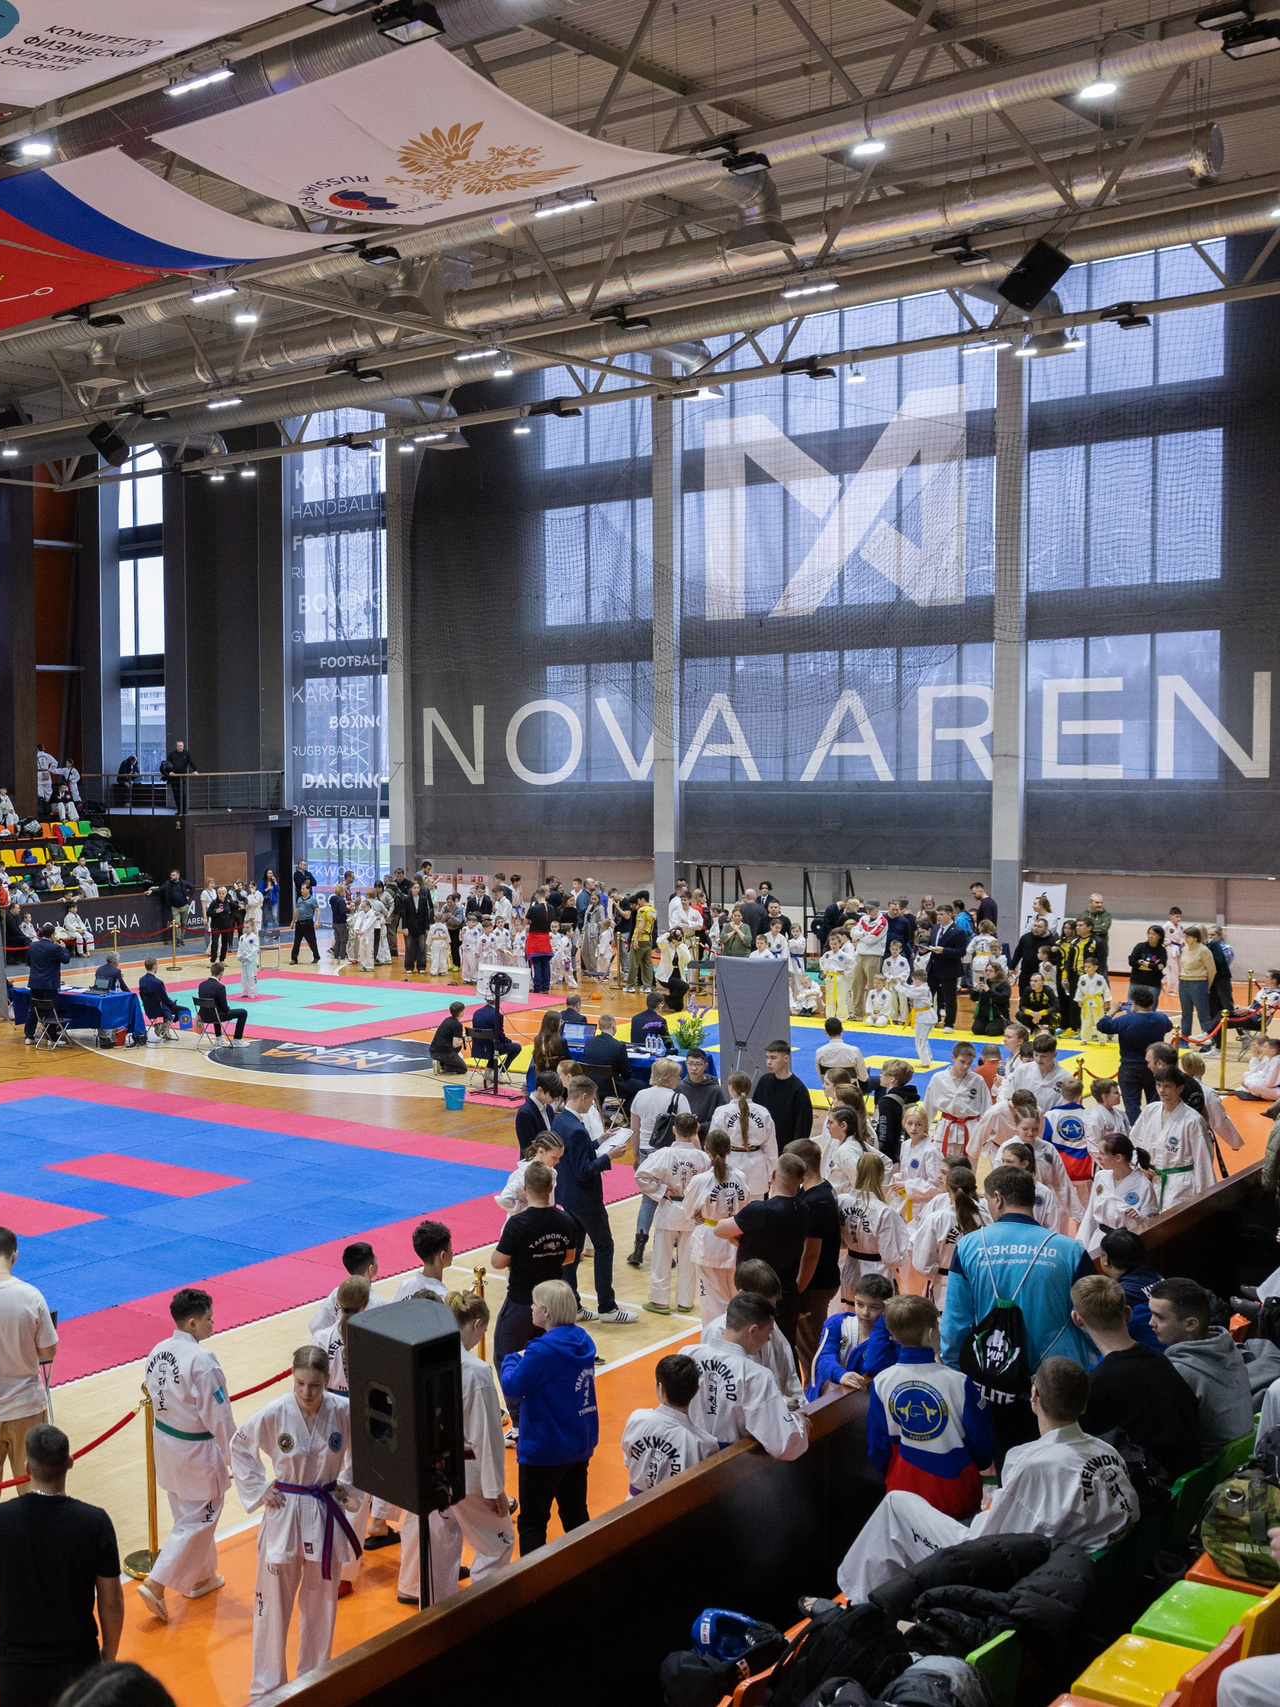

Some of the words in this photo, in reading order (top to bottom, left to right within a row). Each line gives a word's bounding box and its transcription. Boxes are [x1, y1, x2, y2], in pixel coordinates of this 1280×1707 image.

[23, 35, 151, 58] ФИЗИЧЕСКОЙ
[45, 25, 137, 43] КОМИТЕТ
[131, 39, 165, 47] ПО
[0, 46, 93, 65] КУЛЬТУРЕ
[0, 59, 80, 72] СПОРТУ
[291, 495, 380, 520] HANDBALL
[291, 683, 368, 704] KARATE
[423, 692, 761, 786] NOVA
[291, 745, 358, 757] RUGBYBALL
[292, 805, 373, 818] BASKETBALL
[84, 913, 140, 933] ARENA
[261, 1048, 387, 1070] NOVA
[709, 1181, 745, 1205] TAEKWON-DO
[977, 1244, 1058, 1258] ТХЭКВОНДО
[696, 1359, 738, 1402] KWON-DO
[1082, 1454, 1121, 1500] TAEKWON
